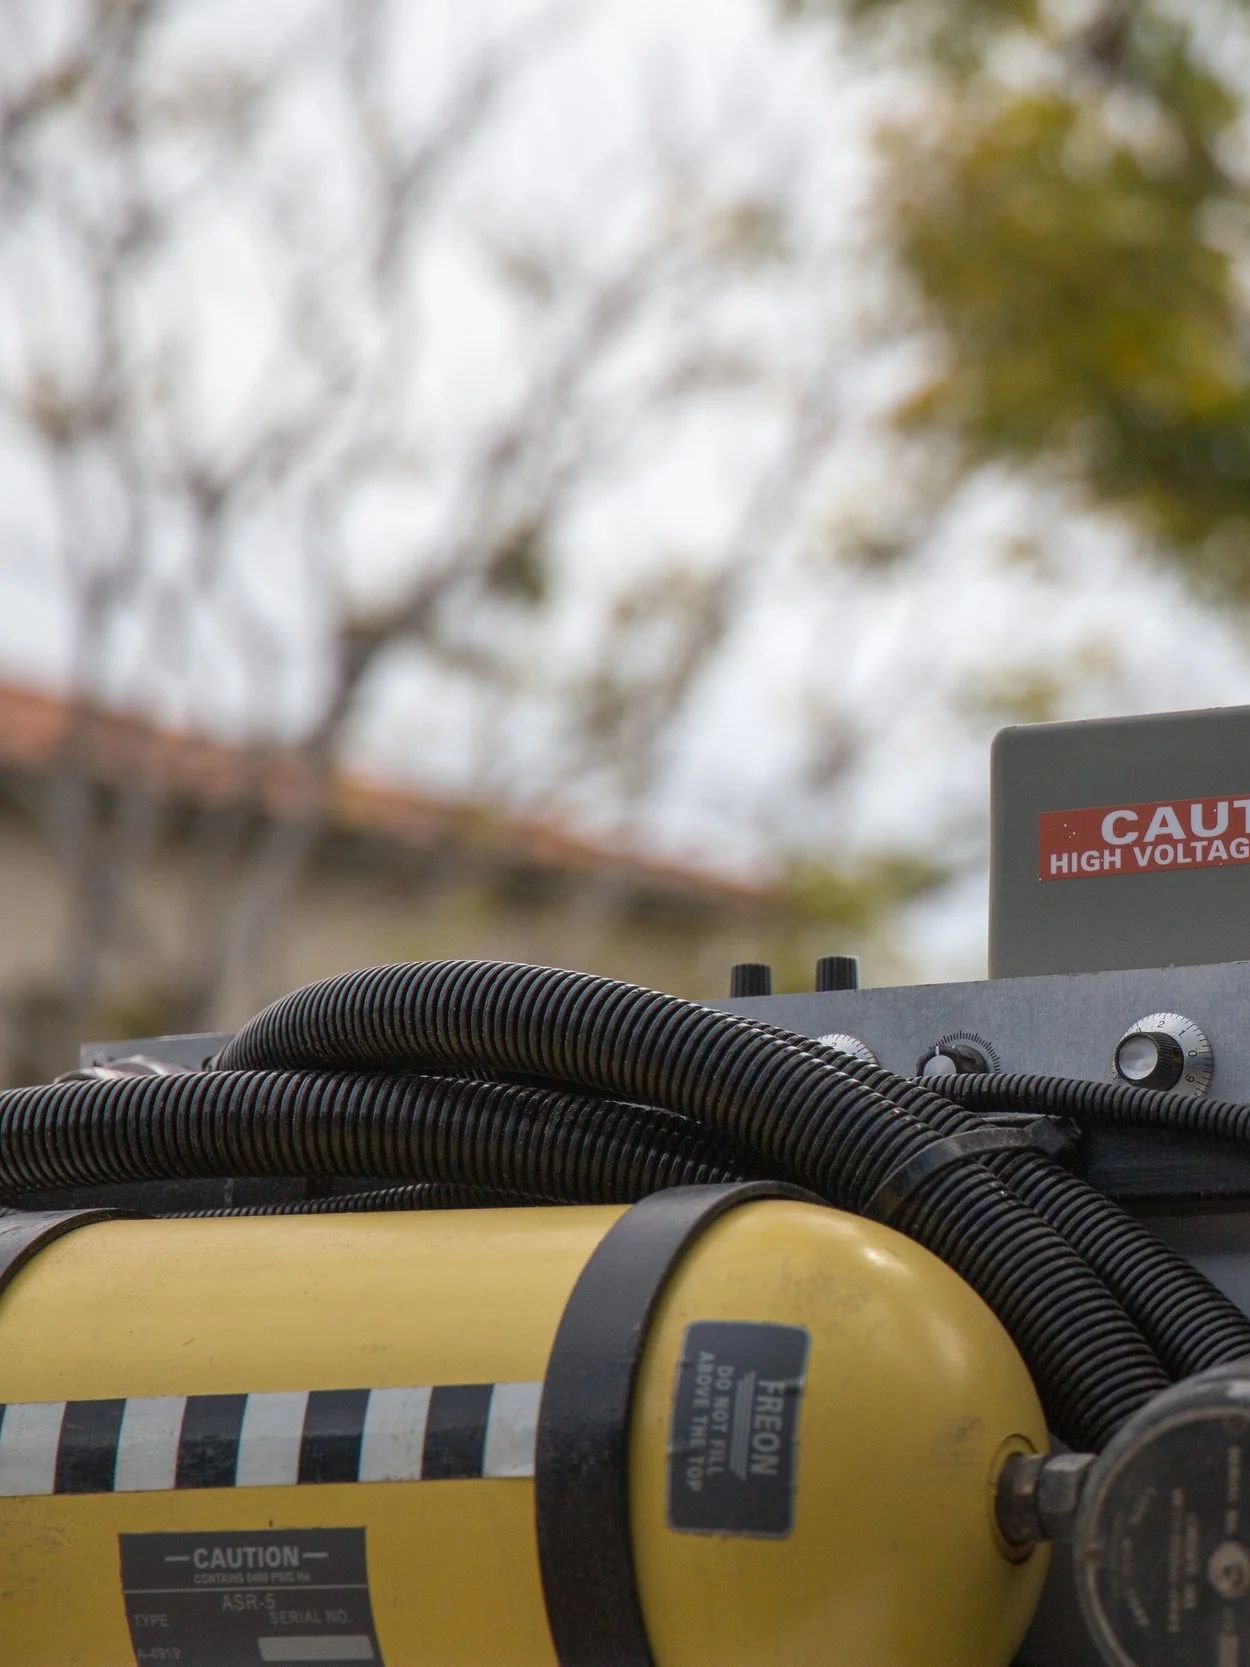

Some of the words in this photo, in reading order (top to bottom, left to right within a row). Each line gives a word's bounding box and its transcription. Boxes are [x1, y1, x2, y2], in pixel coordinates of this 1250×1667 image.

[1050, 847, 1122, 875] HIGH
[1157, 1020, 1165, 1028] 2
[693, 1351, 715, 1408] ABOVE
[715, 1365, 735, 1391] DO
[712, 1397, 730, 1433] NOT
[750, 1379, 786, 1476] FREON
[689, 1415, 708, 1448] THE
[707, 1439, 728, 1478] FILL
[685, 1456, 705, 1492] TOP
[193, 1545, 299, 1569] CAUTION
[193, 1573, 244, 1585] CONTAINS
[221, 1593, 276, 1612] ASR-5
[133, 1614, 170, 1628] TYPE
[269, 1610, 322, 1625] SERIAL
